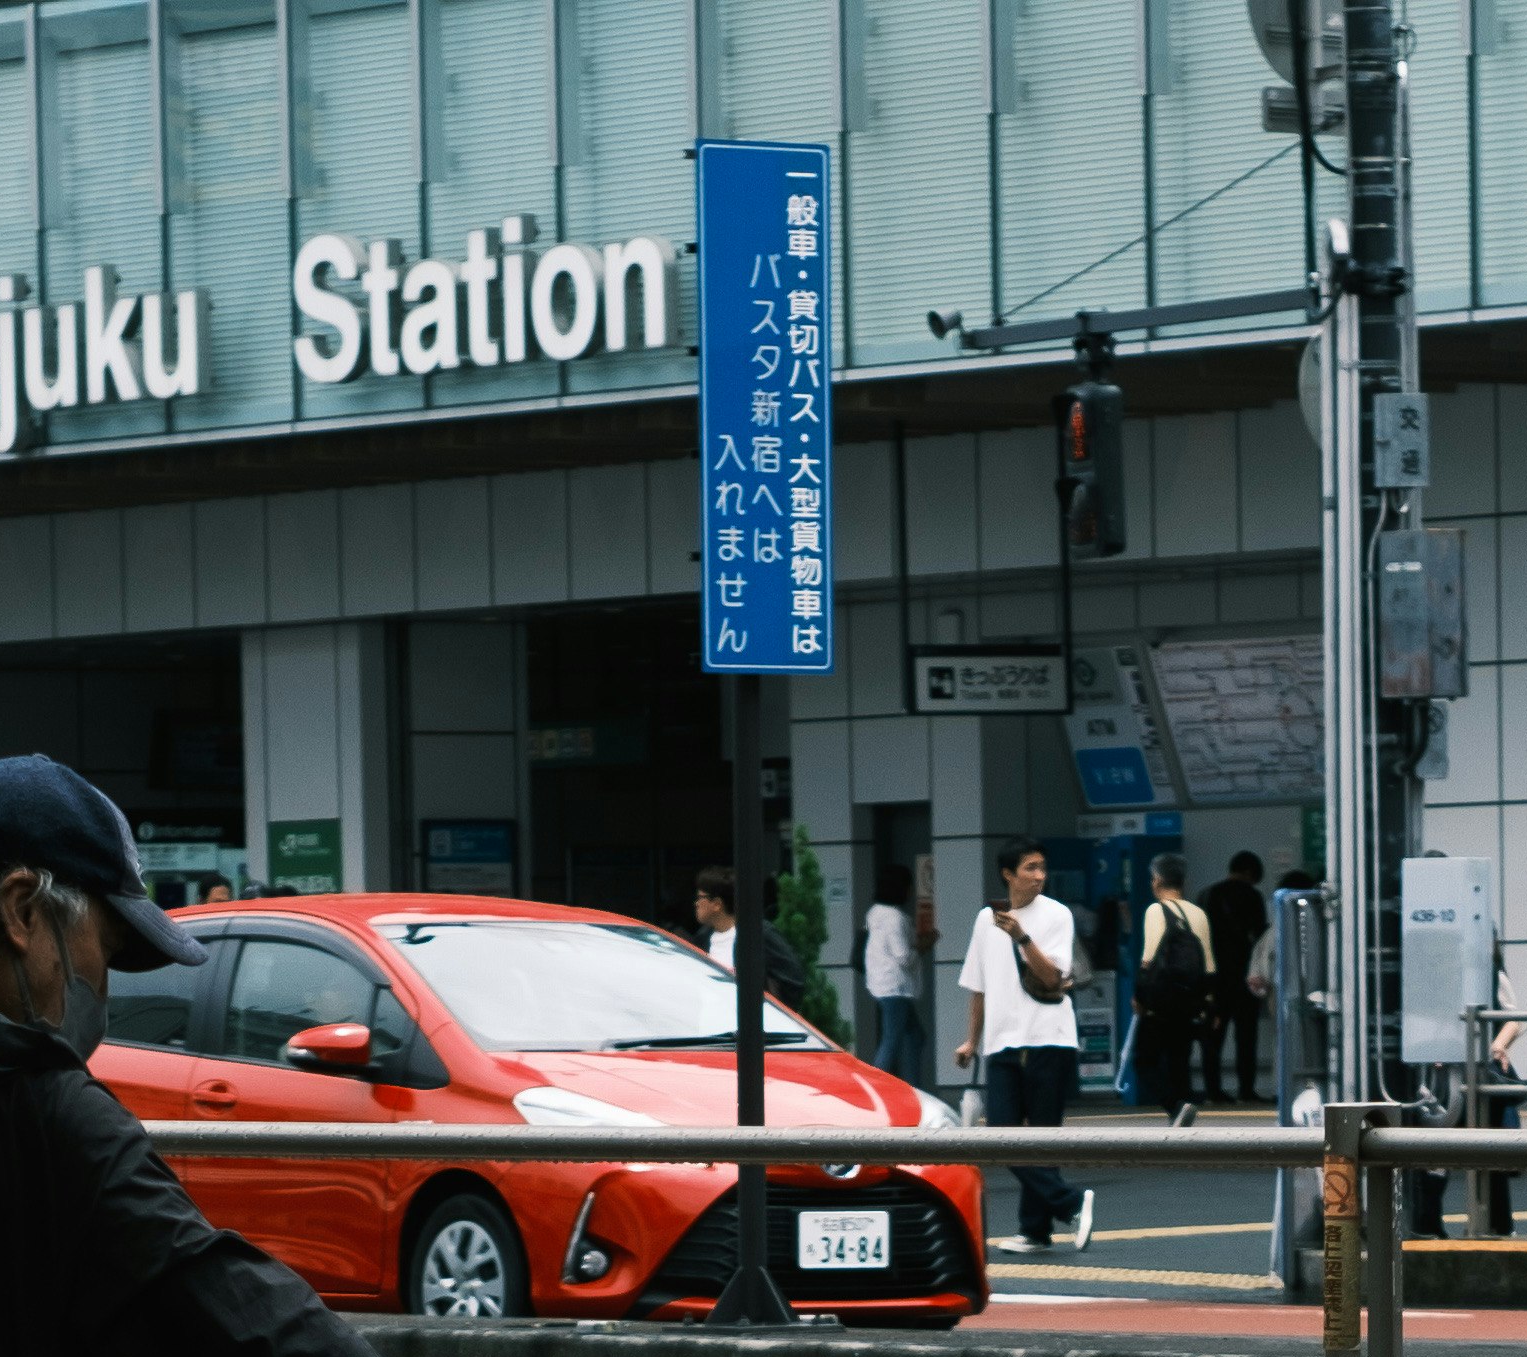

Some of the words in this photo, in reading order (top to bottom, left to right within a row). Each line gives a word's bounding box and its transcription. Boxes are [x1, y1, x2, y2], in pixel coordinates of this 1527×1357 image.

[293, 213, 680, 383] Station
[750, 253, 784, 564] バスタ新宿へは
[785, 172, 823, 654] 一般車・貸切バス・大型貨物車は
[714, 434, 748, 653] 入れません
[819, 1236, 883, 1263] 34-84
